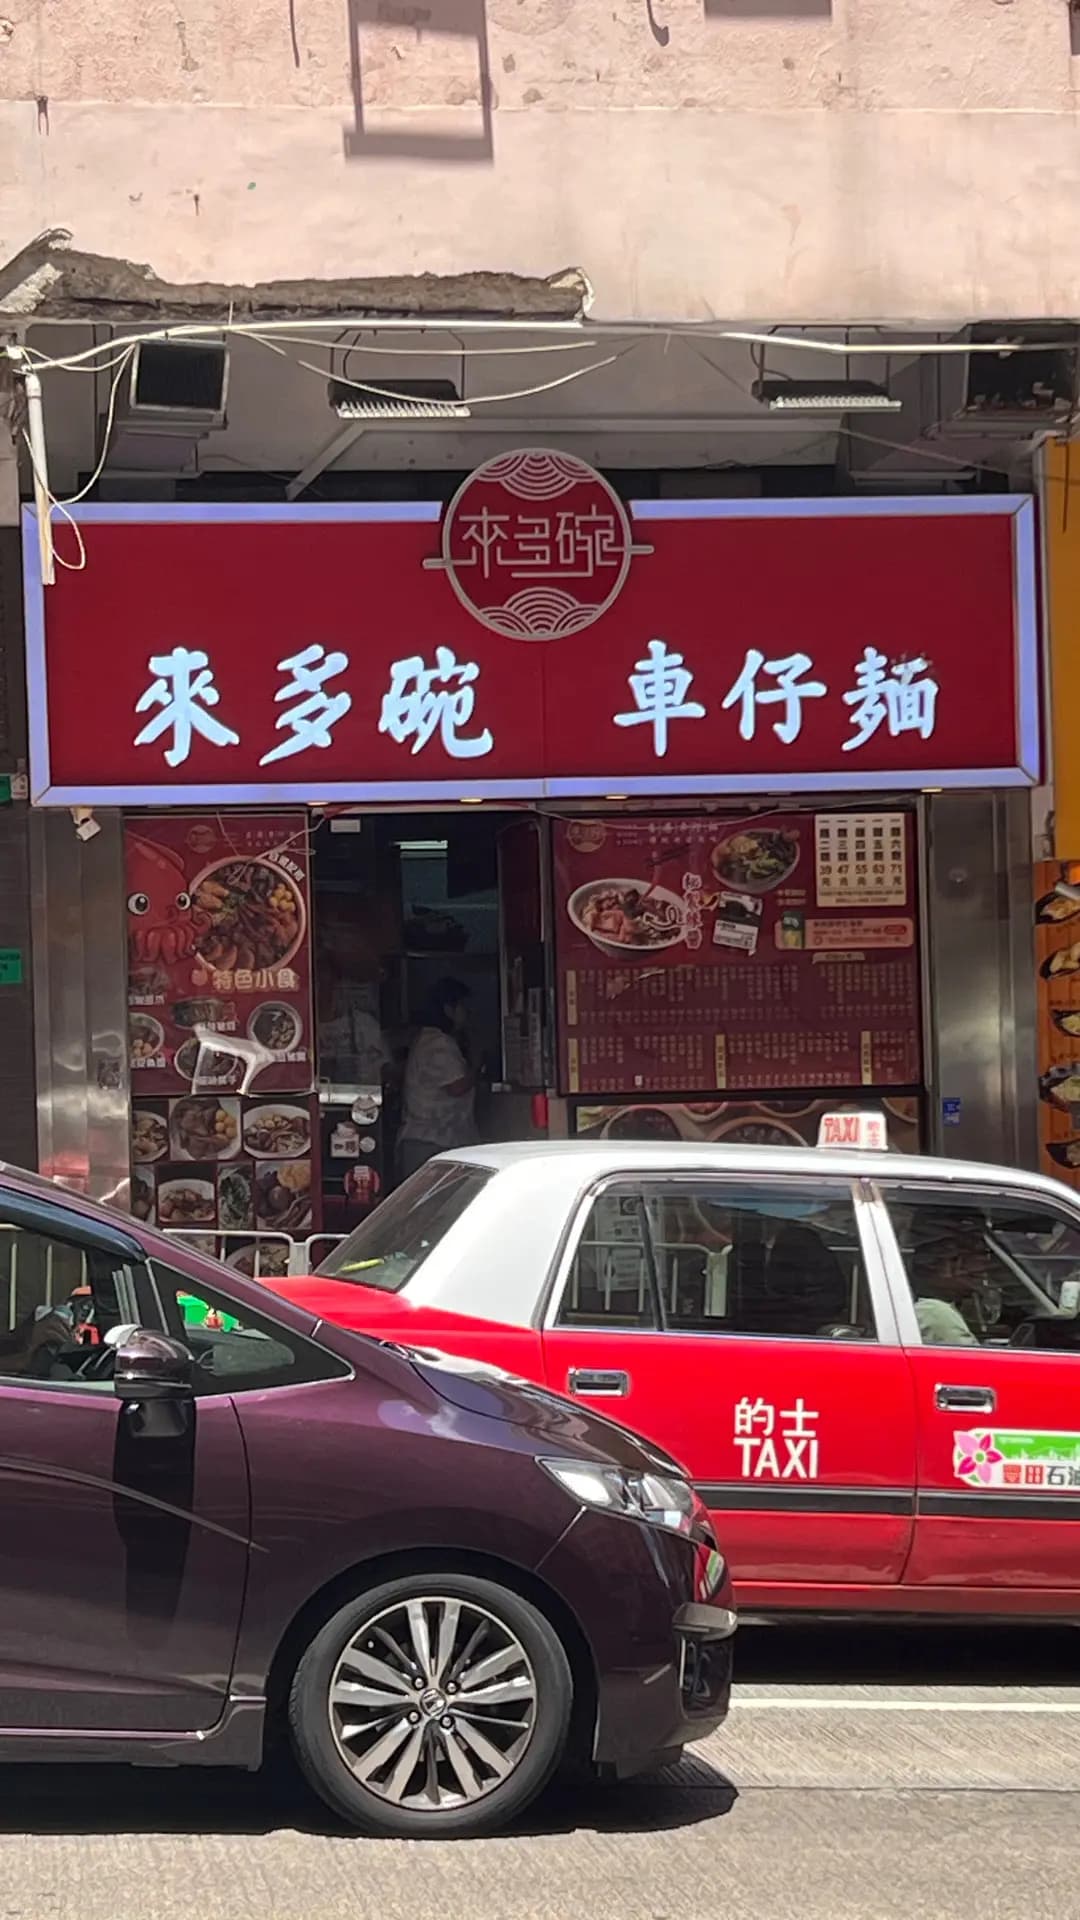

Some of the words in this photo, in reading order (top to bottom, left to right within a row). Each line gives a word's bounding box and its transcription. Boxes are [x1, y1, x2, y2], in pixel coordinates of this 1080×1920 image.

[456, 504, 619, 578] 來多碗
[134, 645, 493, 766] 來多碗
[614, 640, 938, 756] 車仔麵
[212, 968, 298, 990] 特色小食
[824, 1116, 860, 1142] TAXI
[733, 1397, 820, 1437] 的士
[733, 1438, 819, 1480] TAXI
